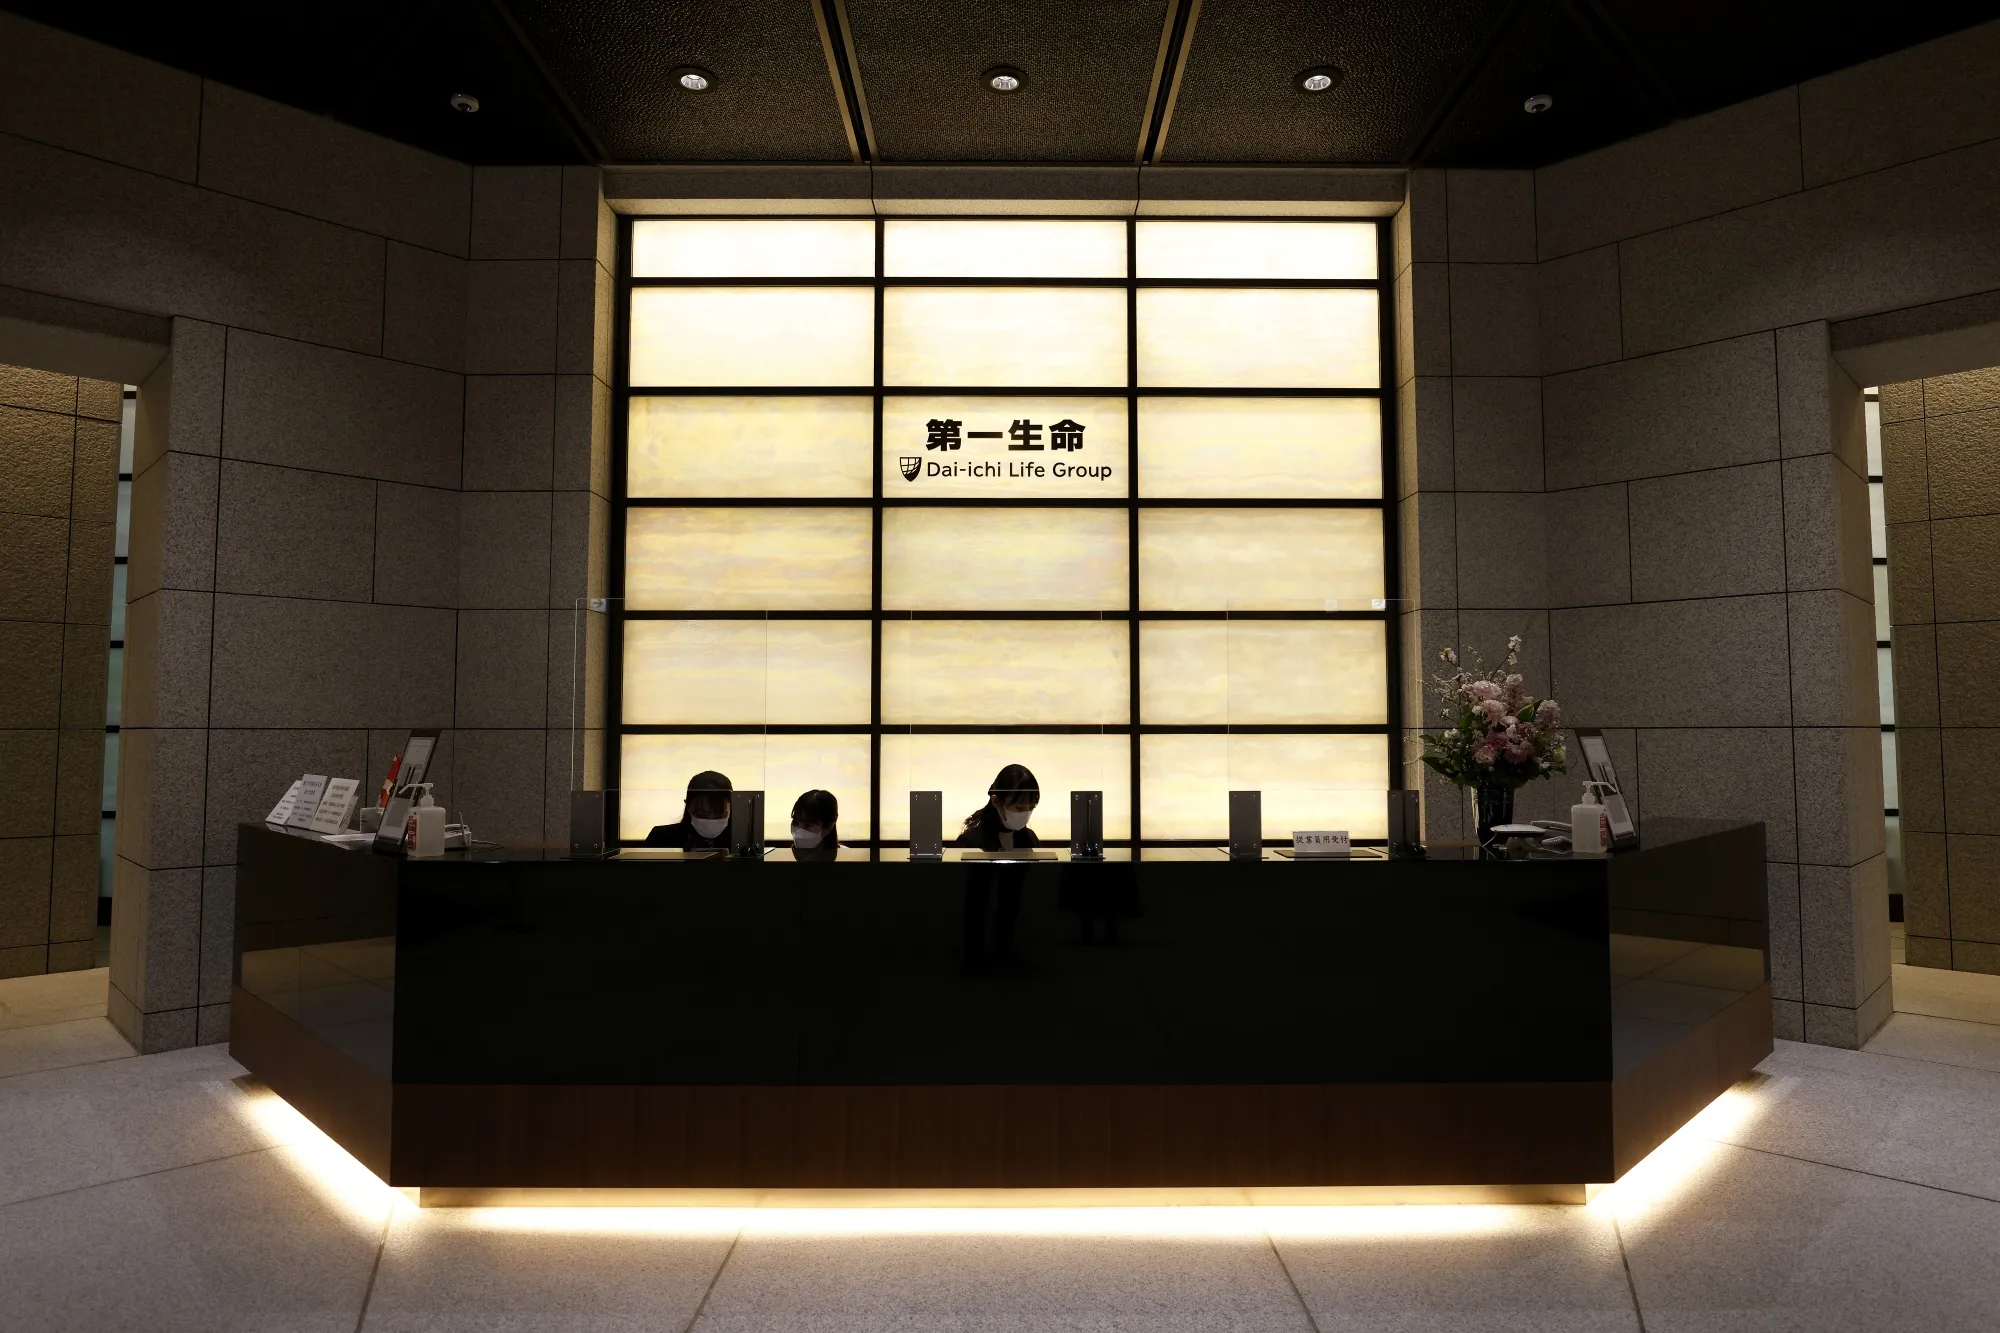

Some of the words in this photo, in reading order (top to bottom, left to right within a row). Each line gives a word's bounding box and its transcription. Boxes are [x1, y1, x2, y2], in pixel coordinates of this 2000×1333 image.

[926, 418, 1086, 452] 第一生命
[927, 461, 1001, 477] Dai-ichi
[1009, 461, 1045, 478] Life
[1052, 461, 1112, 481] Group
